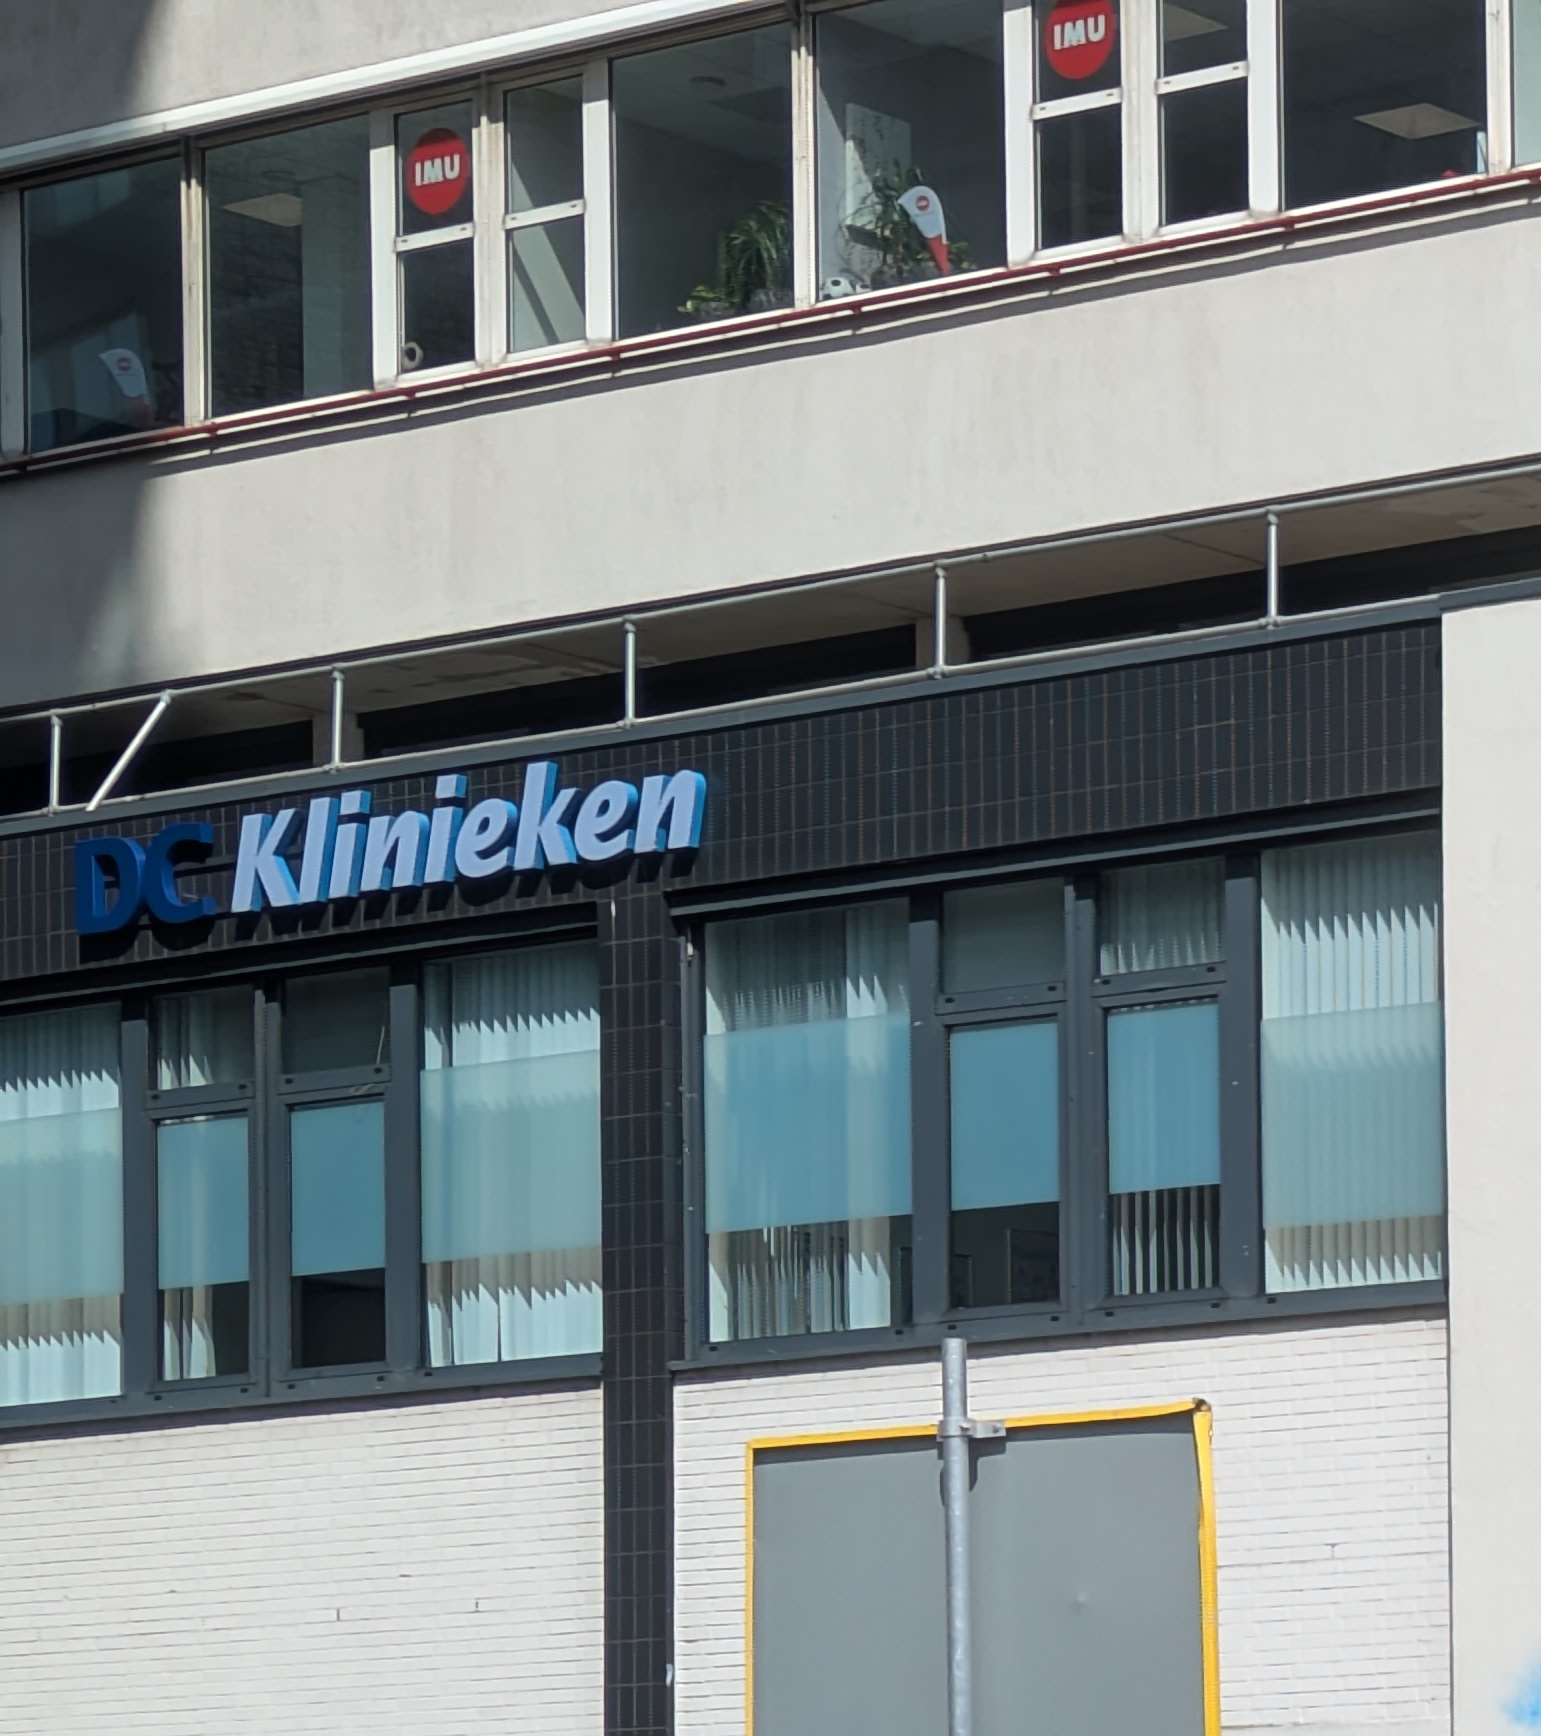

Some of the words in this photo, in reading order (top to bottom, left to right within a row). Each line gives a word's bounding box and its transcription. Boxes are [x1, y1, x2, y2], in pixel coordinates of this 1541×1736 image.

[1053, 14, 1106, 51] IMU
[414, 153, 461, 187] IMU
[75, 822, 216, 936] DC
[231, 761, 707, 914] Klinieken
